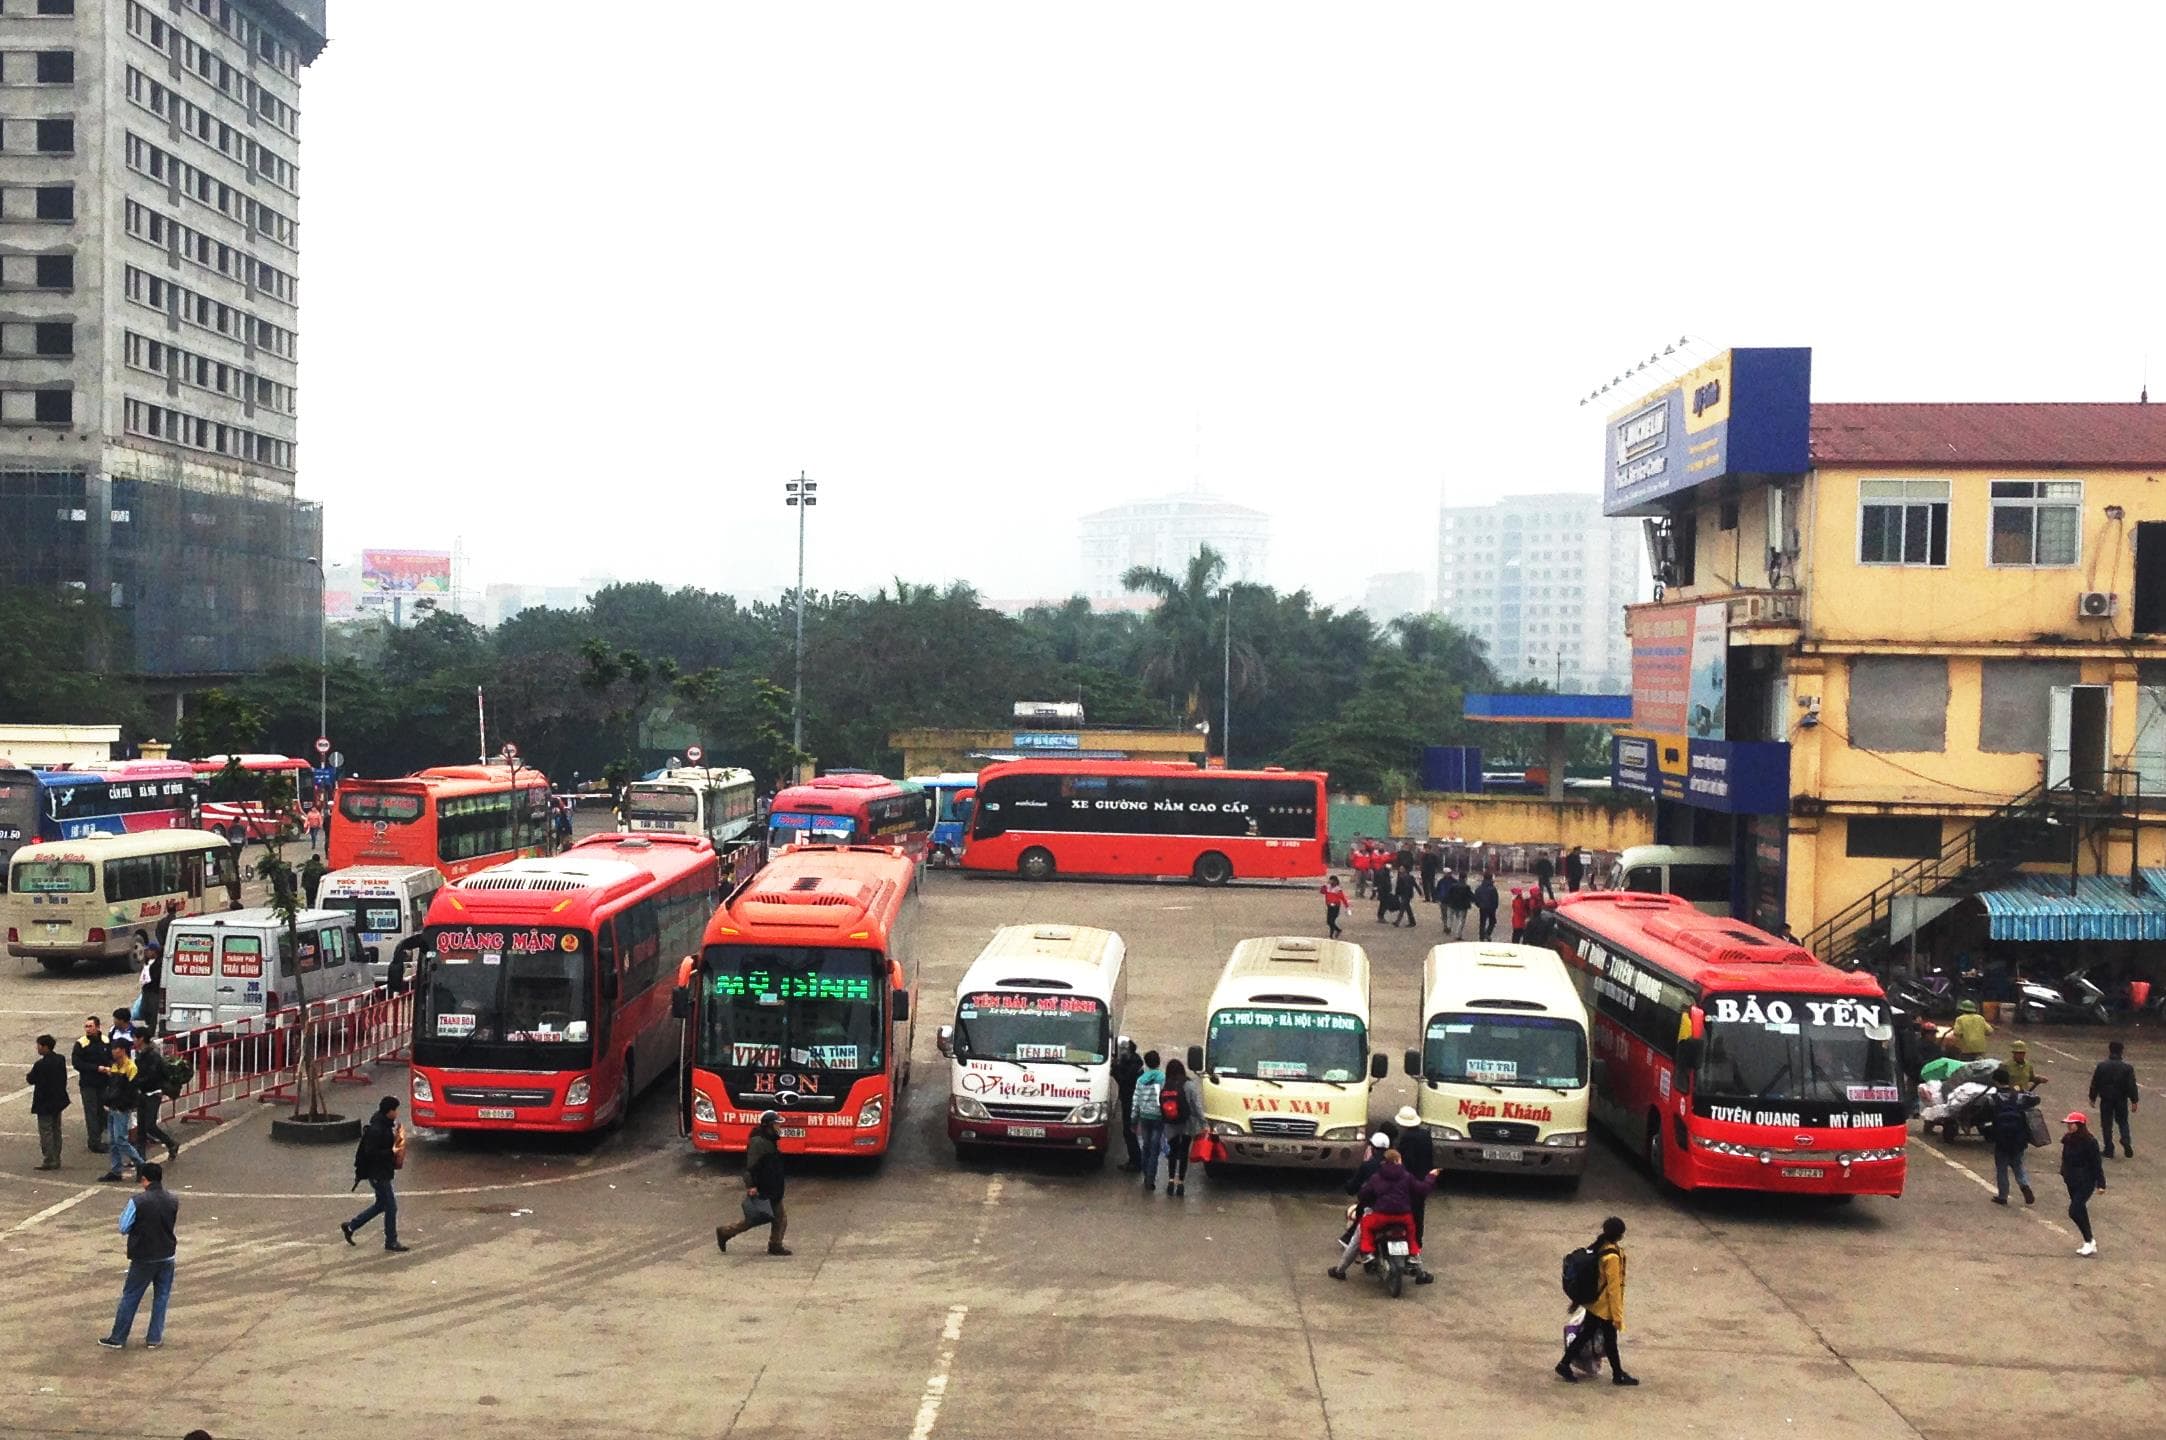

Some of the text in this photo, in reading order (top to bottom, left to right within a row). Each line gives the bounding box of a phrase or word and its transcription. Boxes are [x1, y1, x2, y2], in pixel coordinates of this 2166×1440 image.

[1071, 798, 1249, 813] XE GIƯỜNG NẰM CAO CẤP
[436, 926, 505, 953] QUẢNG
[511, 928, 557, 955] MẬN
[716, 971, 770, 996] MỸ
[972, 993, 1000, 1008] YÊN
[1002, 993, 1027, 1008] BÁI
[1037, 996, 1058, 1011] MỸ
[1715, 994, 1793, 1023] BẢO
[1235, 1012, 1254, 1025] PHÚ
[1279, 1012, 1294, 1027] HÀ
[1294, 1012, 1312, 1029] NỘI
[1316, 1014, 1330, 1028] MỸ
[1018, 1046, 1042, 1058] YÊN
[1469, 1060, 1494, 1072] VIỆT
[1289, 1100, 1330, 1114] NAM
[1457, 1099, 1496, 1120] Ngân
[722, 1112, 737, 1122] TP
[807, 1112, 824, 1126] MỸ
[827, 1112, 853, 1126] ĐÌNH
[1710, 1105, 1883, 1128] TUYÊN QUANG MỸ ĐÌNH
